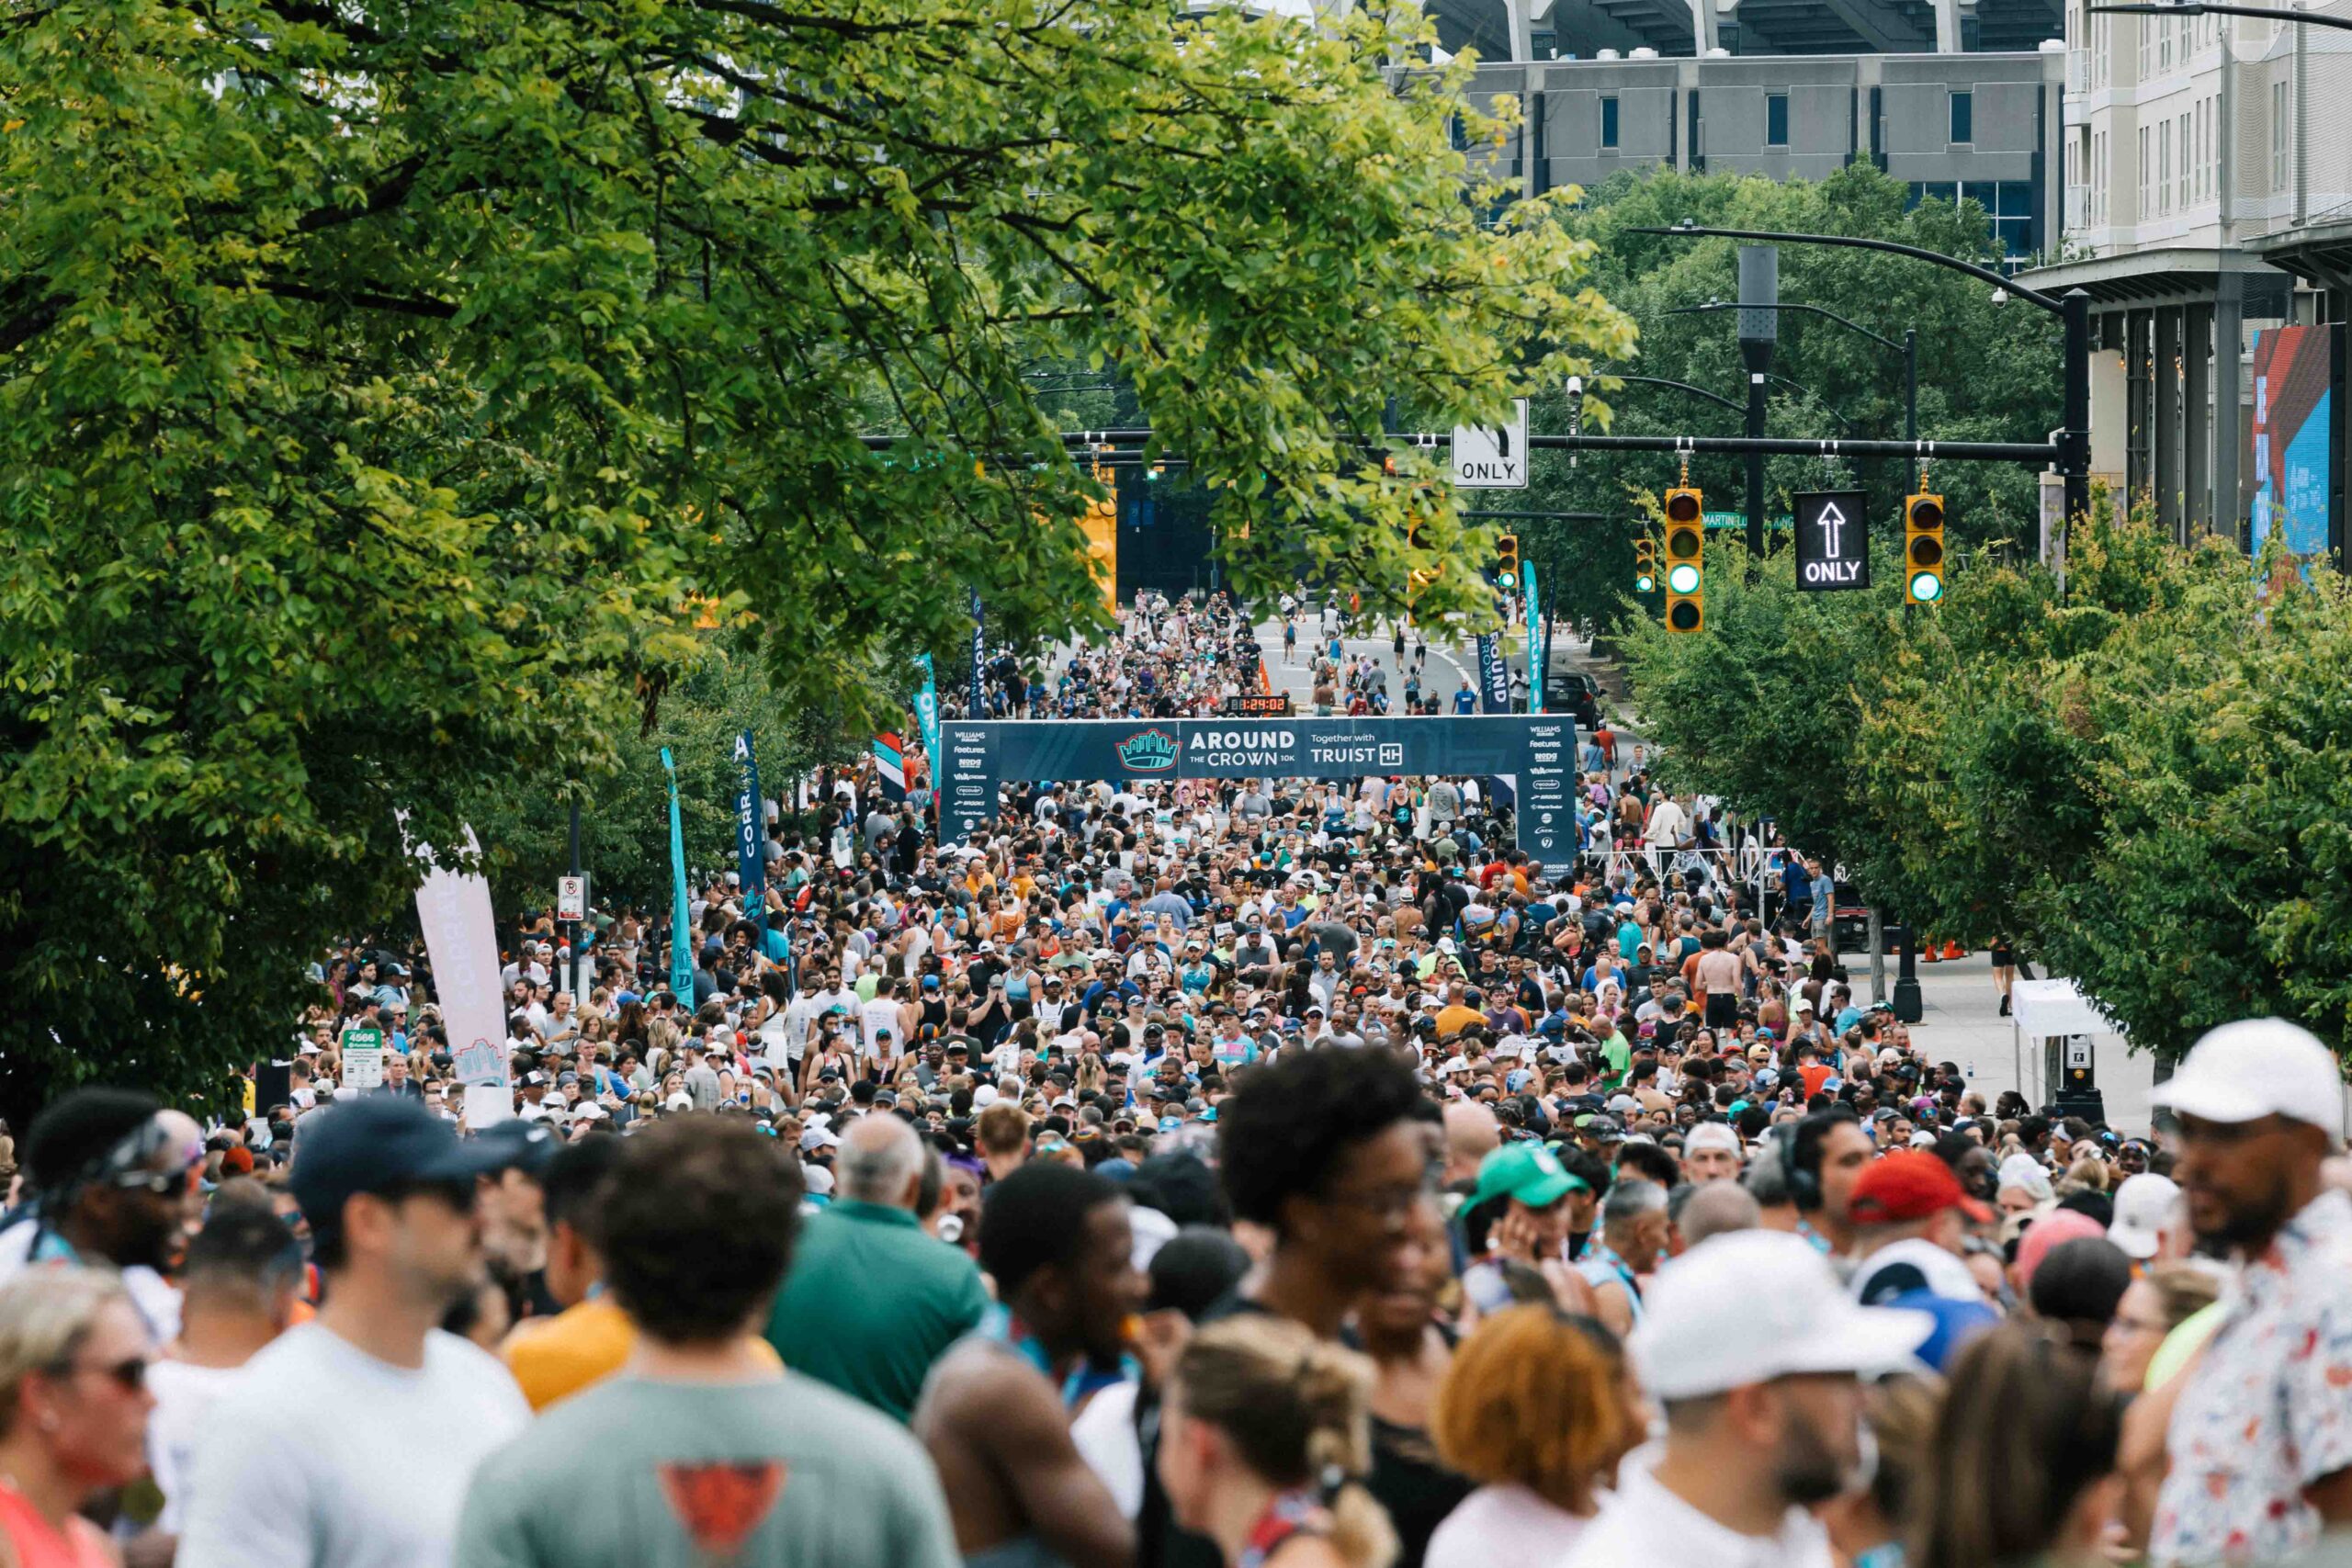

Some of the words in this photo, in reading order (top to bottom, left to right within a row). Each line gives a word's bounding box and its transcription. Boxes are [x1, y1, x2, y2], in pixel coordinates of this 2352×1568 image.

[1462, 462, 1516, 479] ONLY
[1702, 514, 1734, 525] MARTIN
[1805, 561, 1860, 583] ONLY
[1481, 635, 1492, 692] CROWN
[1190, 731, 1295, 750] AROUND
[1311, 734, 1353, 744] Together
[1354, 733, 1375, 742] with
[1207, 751, 1277, 766] CROWN
[1281, 754, 1295, 762] 10K
[1310, 748, 1375, 763] TRUIST
[738, 765, 755, 858] CORR
